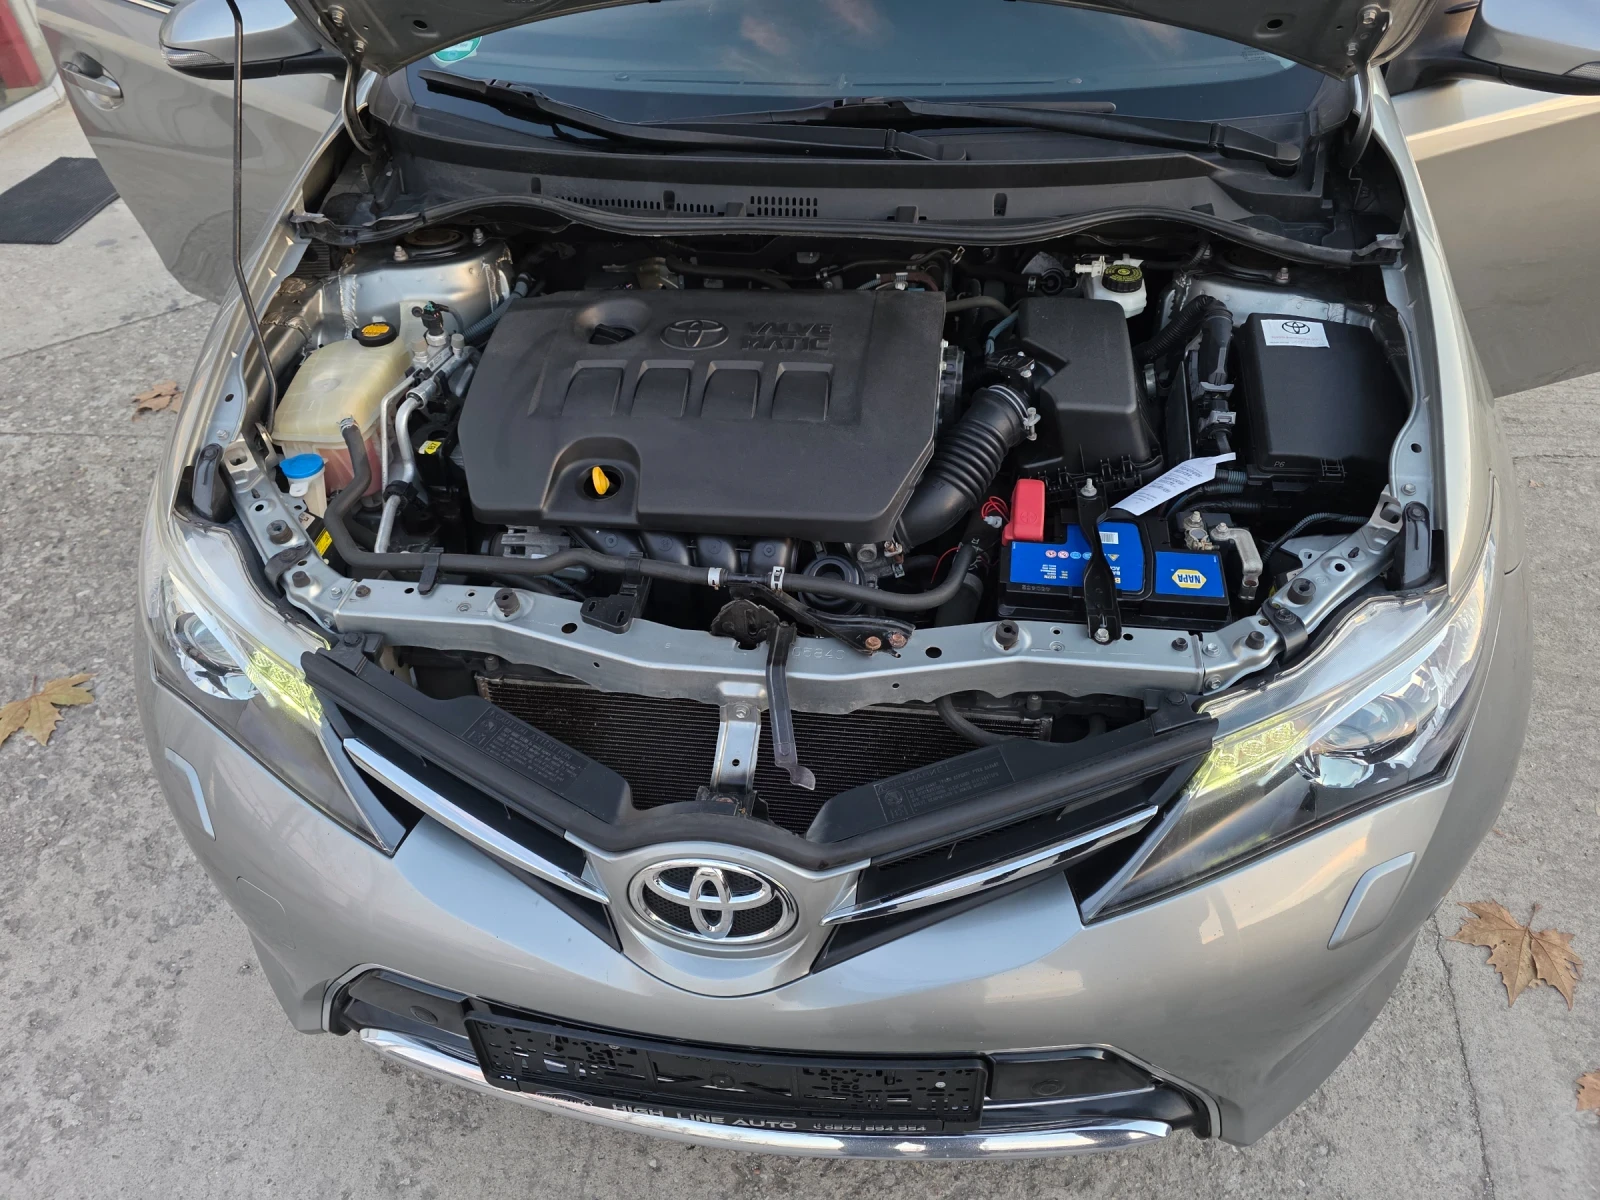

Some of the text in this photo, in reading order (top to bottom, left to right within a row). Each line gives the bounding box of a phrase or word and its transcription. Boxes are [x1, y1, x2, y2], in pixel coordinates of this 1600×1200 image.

[1177, 573, 1202, 584] NAPA
[612, 1103, 797, 1129] HIGH LINE AUTO
